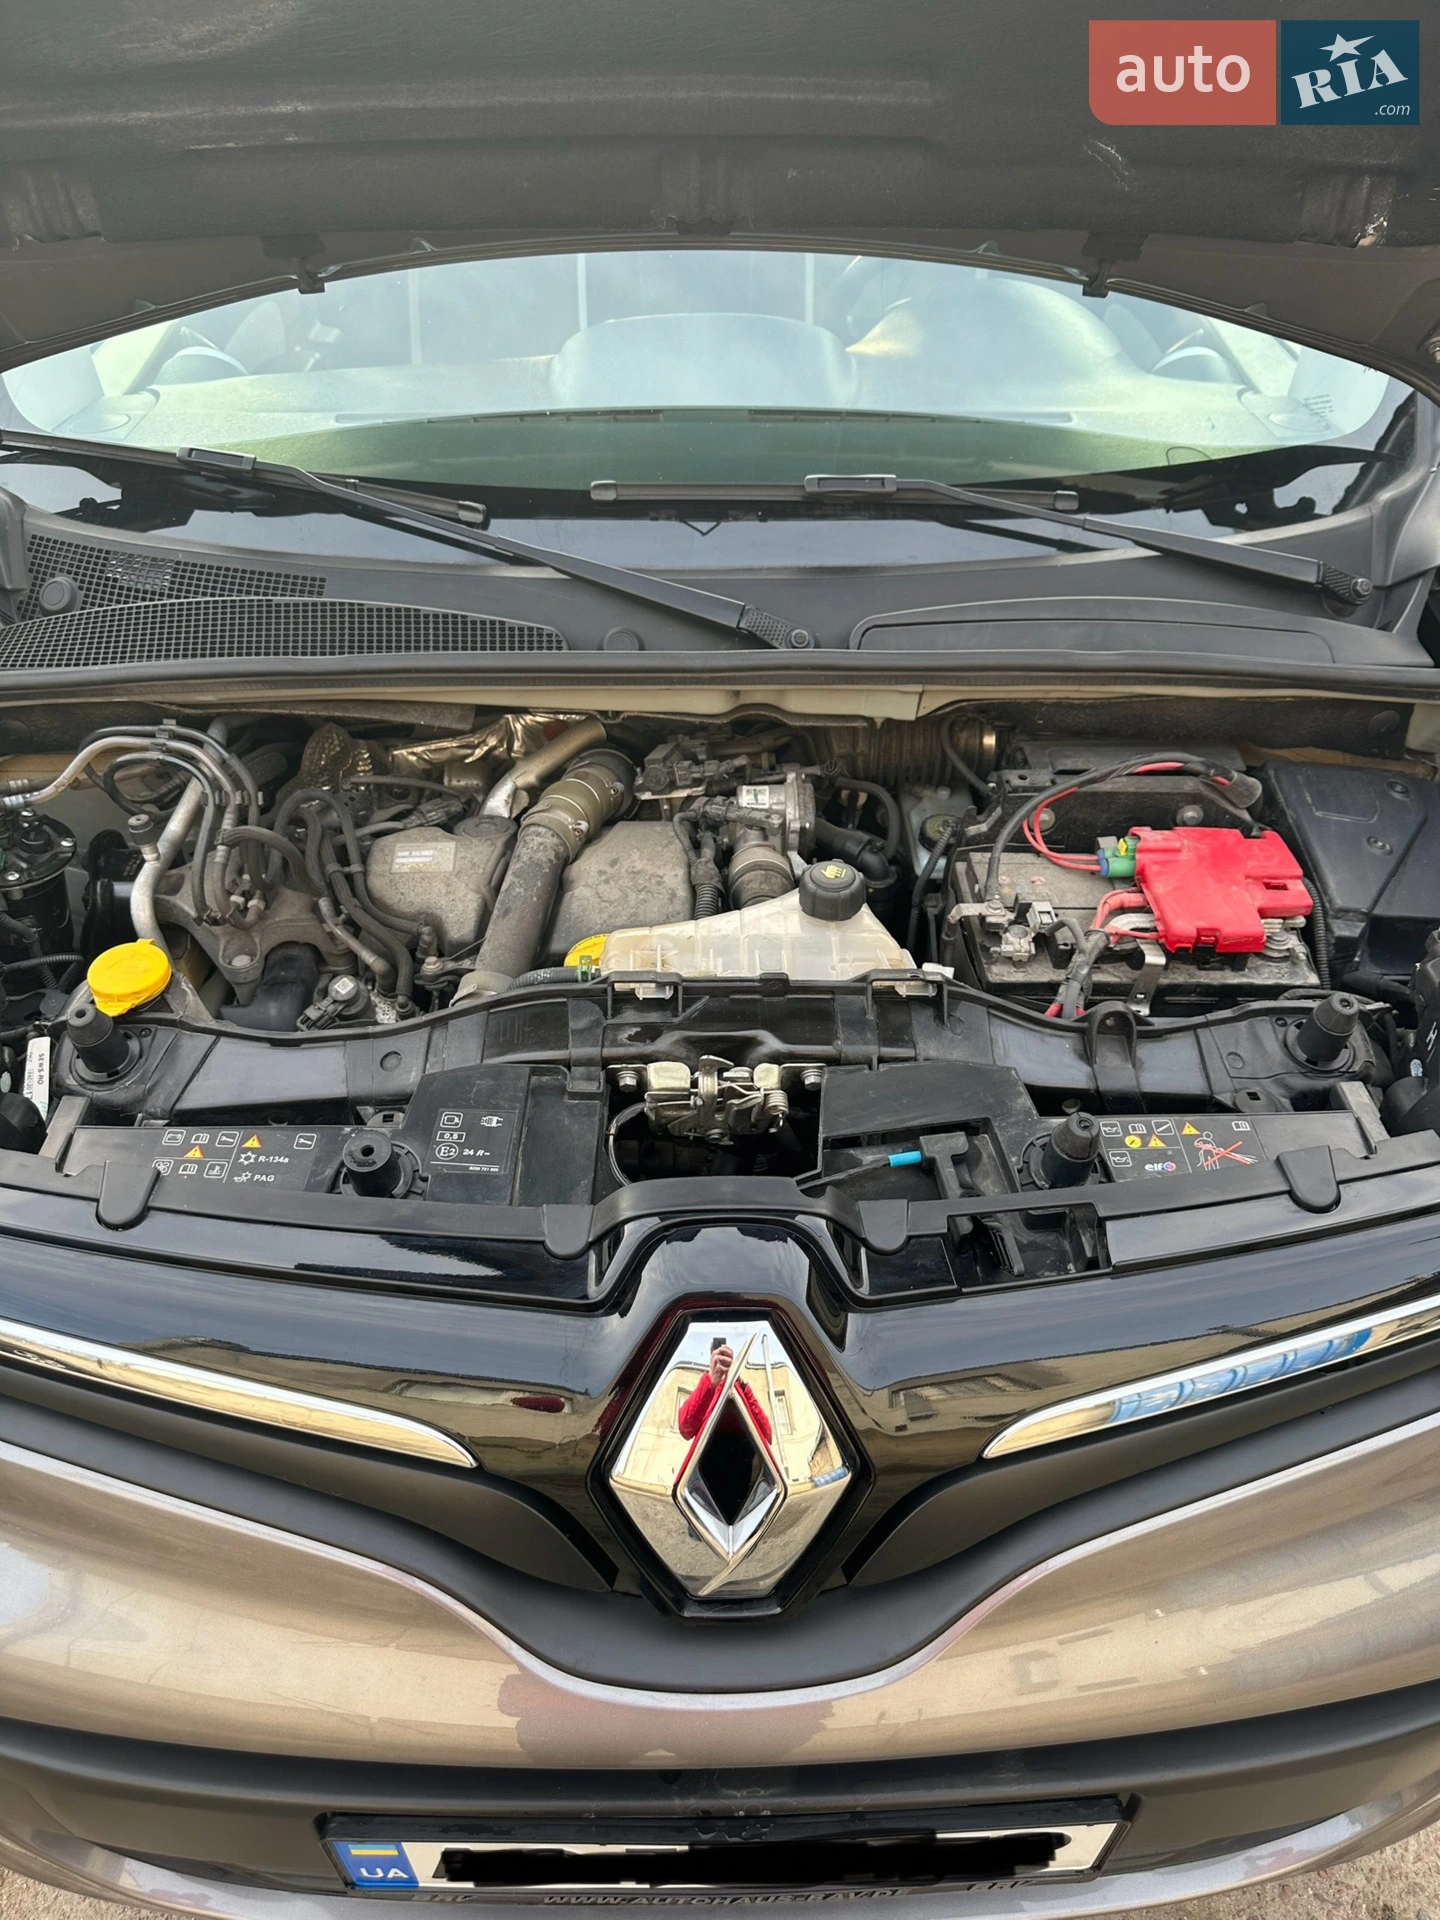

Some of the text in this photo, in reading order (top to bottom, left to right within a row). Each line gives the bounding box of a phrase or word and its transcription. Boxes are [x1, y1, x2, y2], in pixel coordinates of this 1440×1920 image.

[439, 1146, 456, 1157] E2
[257, 1155, 290, 1163] R-134a
[1144, 1162, 1165, 1172] elf
[253, 1174, 275, 1182] PAG
[360, 1867, 409, 1878] UA
